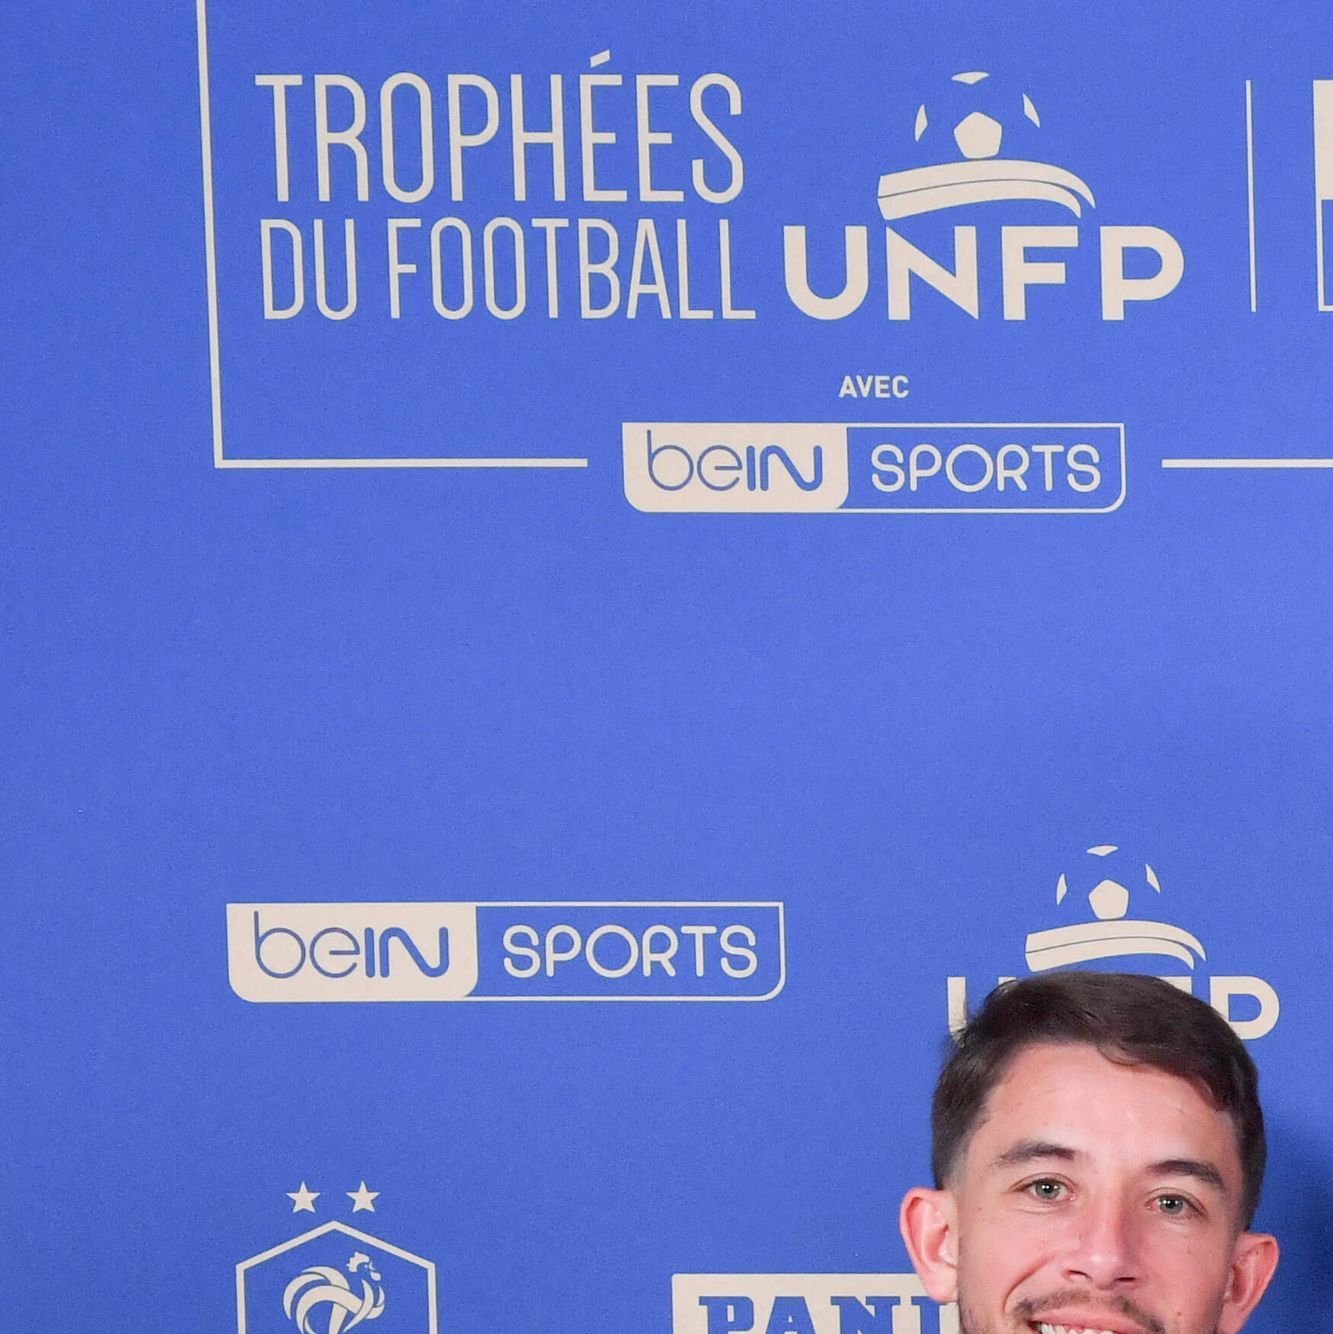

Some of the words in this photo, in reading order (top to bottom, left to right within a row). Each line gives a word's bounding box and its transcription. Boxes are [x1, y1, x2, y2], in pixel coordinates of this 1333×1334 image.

[255, 50, 743, 203] TROPHÉES
[261, 219, 357, 320] DU
[388, 217, 755, 319] FOOTBALL
[784, 226, 1184, 320] UNFP
[839, 376, 908, 398] AVEC
[647, 430, 822, 491] beIN
[872, 444, 1100, 492] SPORTS
[254, 911, 449, 978] beIN
[503, 925, 757, 978] SPORTS
